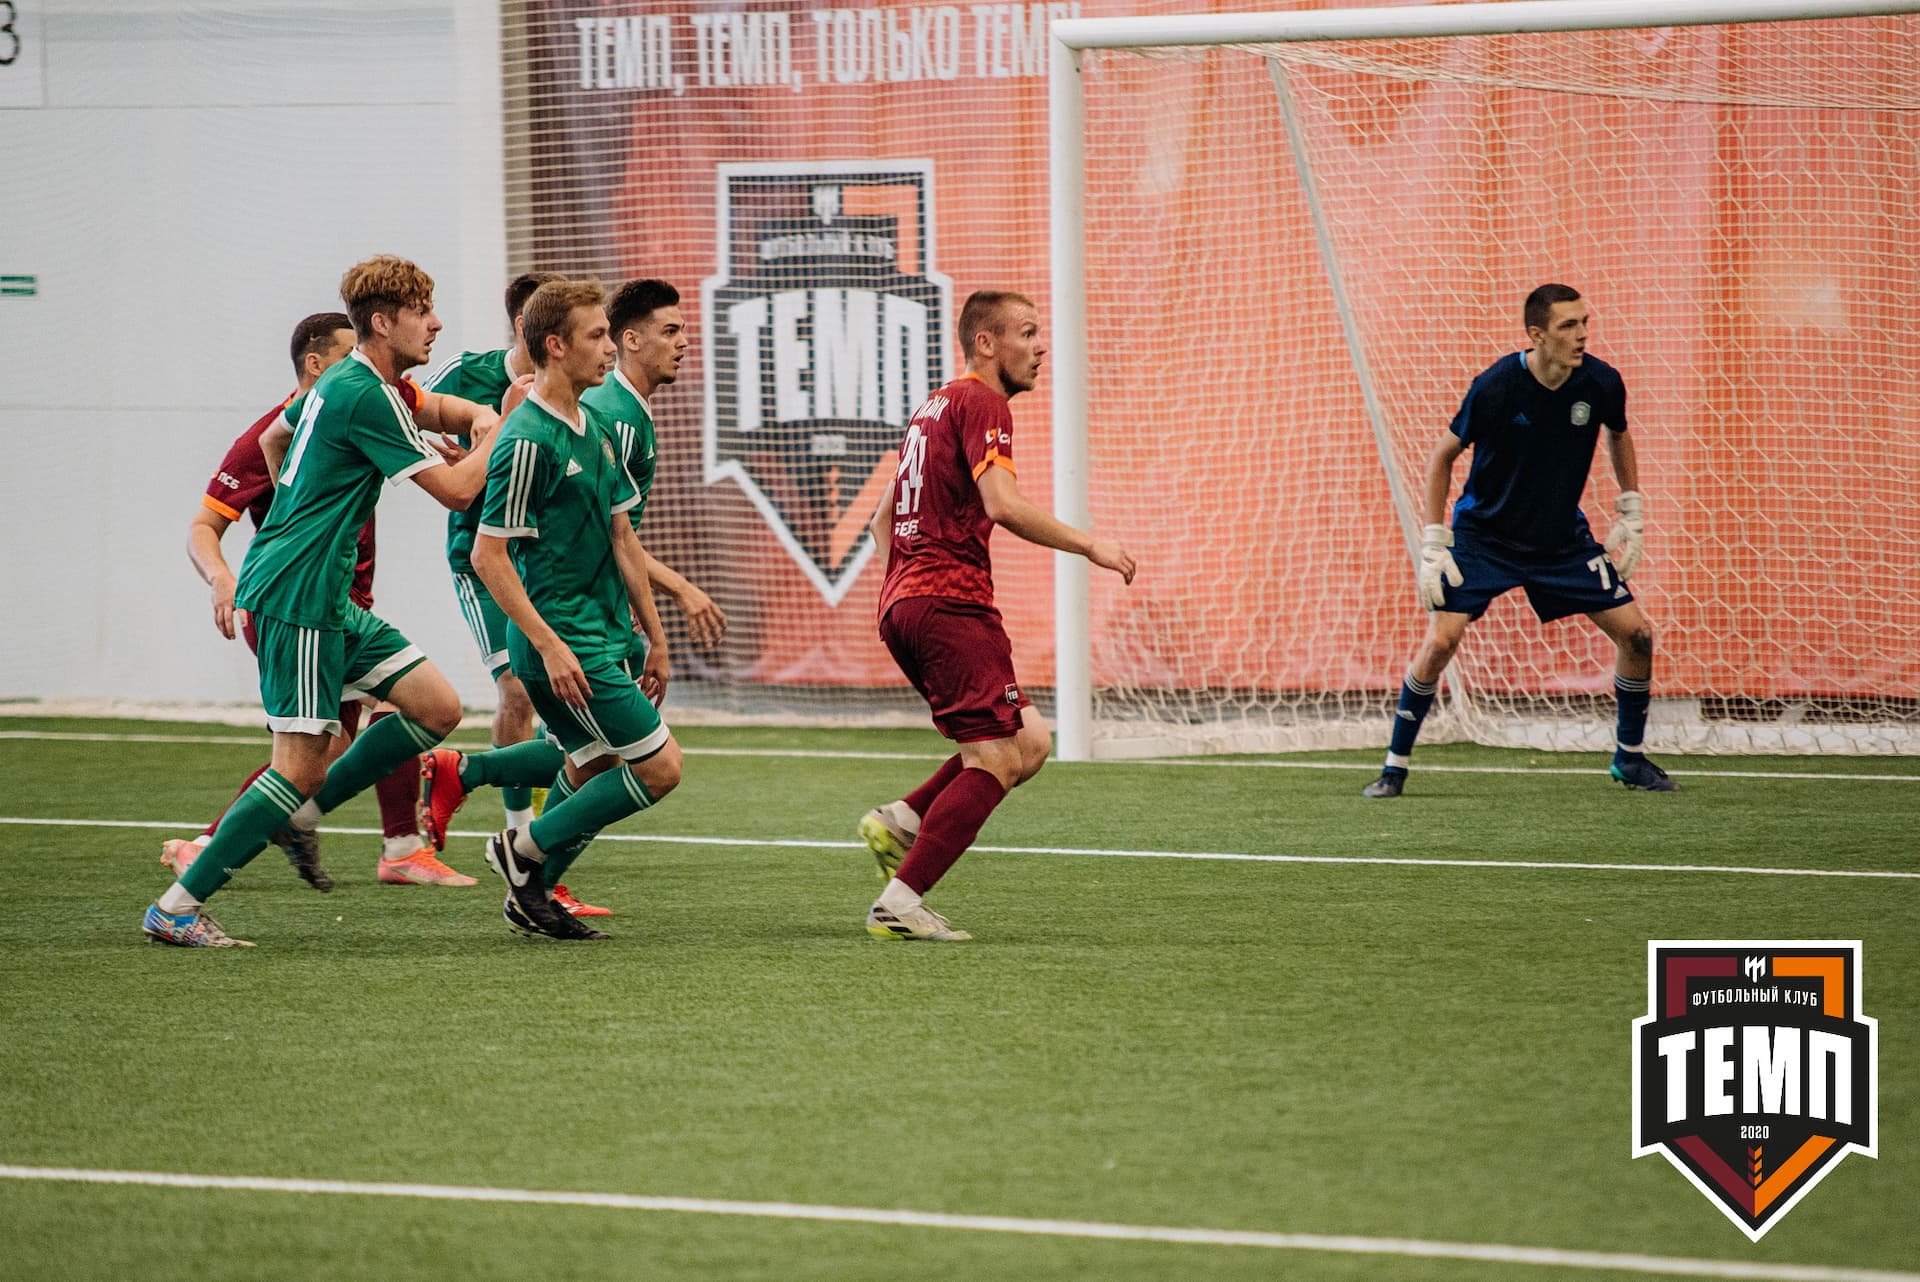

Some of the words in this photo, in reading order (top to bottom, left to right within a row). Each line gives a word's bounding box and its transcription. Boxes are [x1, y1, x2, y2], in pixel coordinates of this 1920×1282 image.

[576, 15, 684, 96] ТЕМП,
[691, 13, 802, 93] ТЕМП,
[812, 7, 960, 84] ТОЛЬКО
[971, 3, 1081, 77] ТЕМ
[728, 287, 928, 432] ТЕМП
